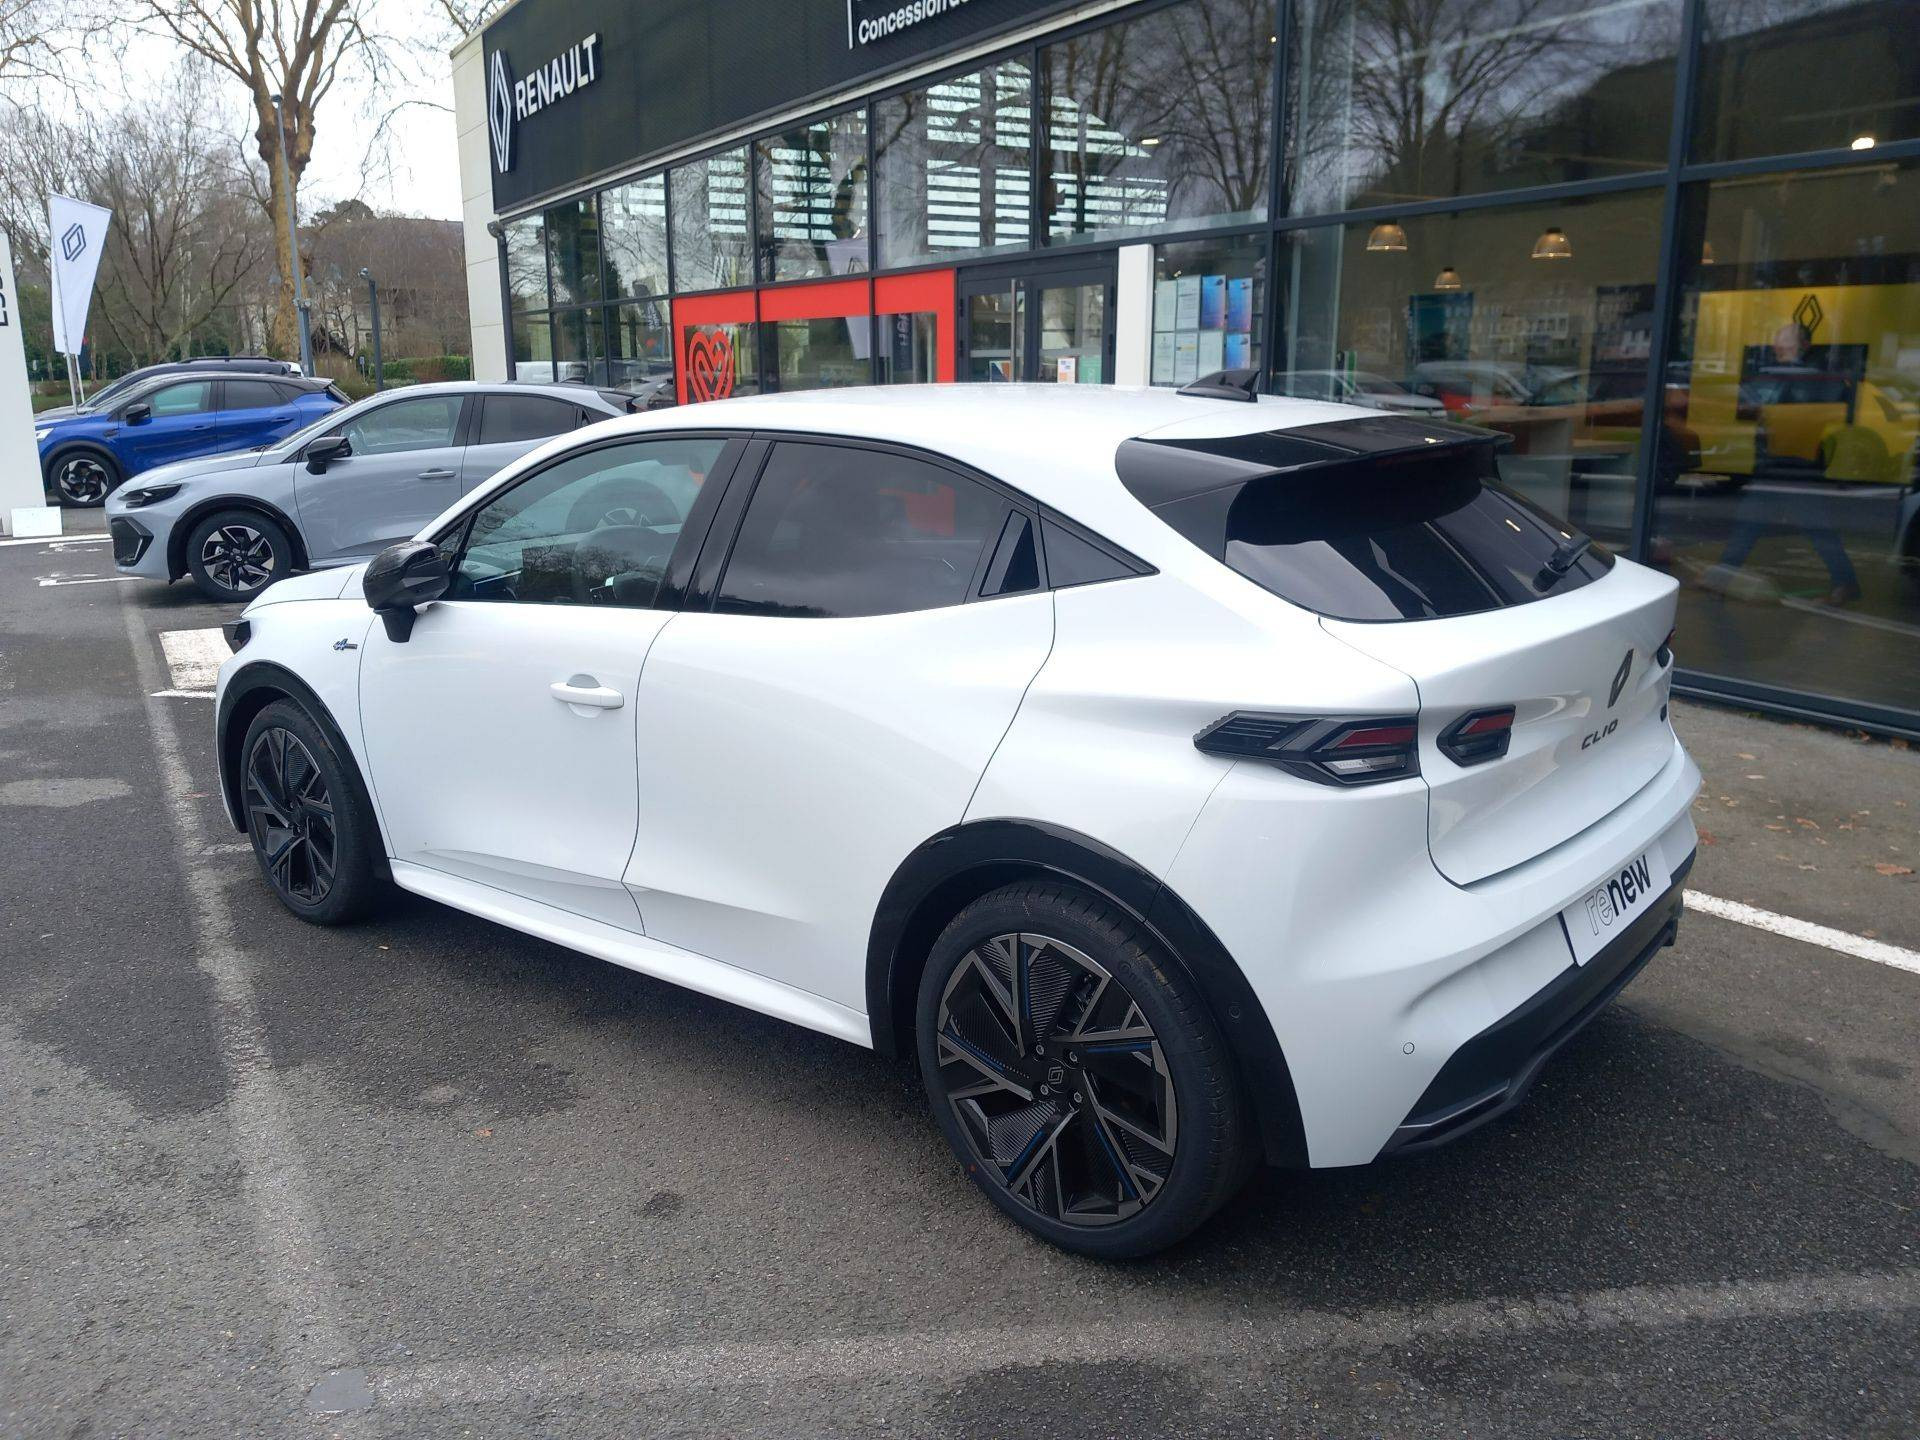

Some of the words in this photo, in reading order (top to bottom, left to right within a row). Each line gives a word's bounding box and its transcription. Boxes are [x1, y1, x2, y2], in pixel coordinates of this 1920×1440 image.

[514, 33, 597, 121] RENAULT
[1581, 718, 1619, 750] CLIO
[1584, 854, 1652, 936] renew
